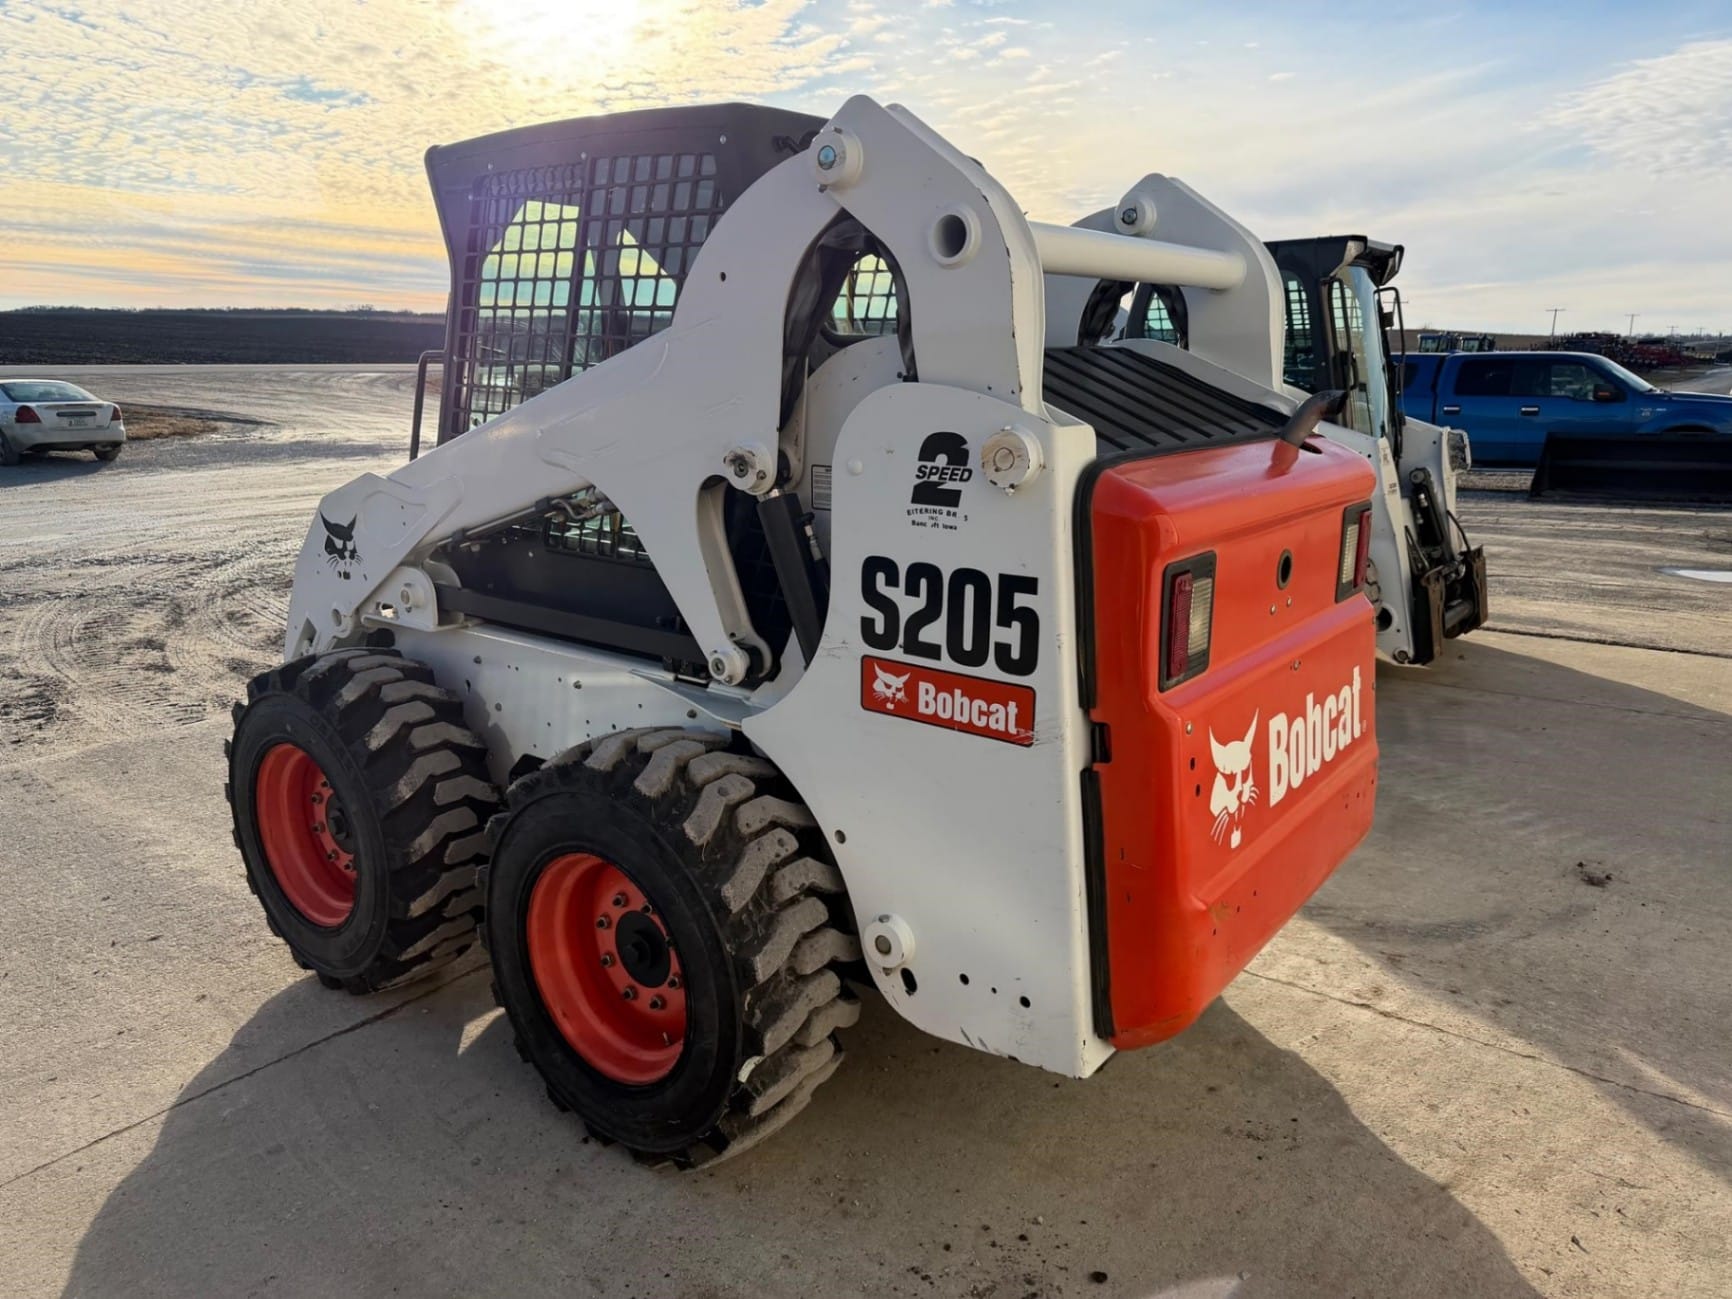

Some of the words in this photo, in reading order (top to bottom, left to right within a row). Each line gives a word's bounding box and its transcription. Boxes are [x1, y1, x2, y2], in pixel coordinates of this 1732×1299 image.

[911, 431, 970, 508] 2
[915, 465, 973, 483] SPEED
[946, 510, 968, 522] BRS
[861, 555, 1039, 676] S205
[918, 681, 1018, 734] Bobcat
[1269, 665, 1361, 808] Bobcat
